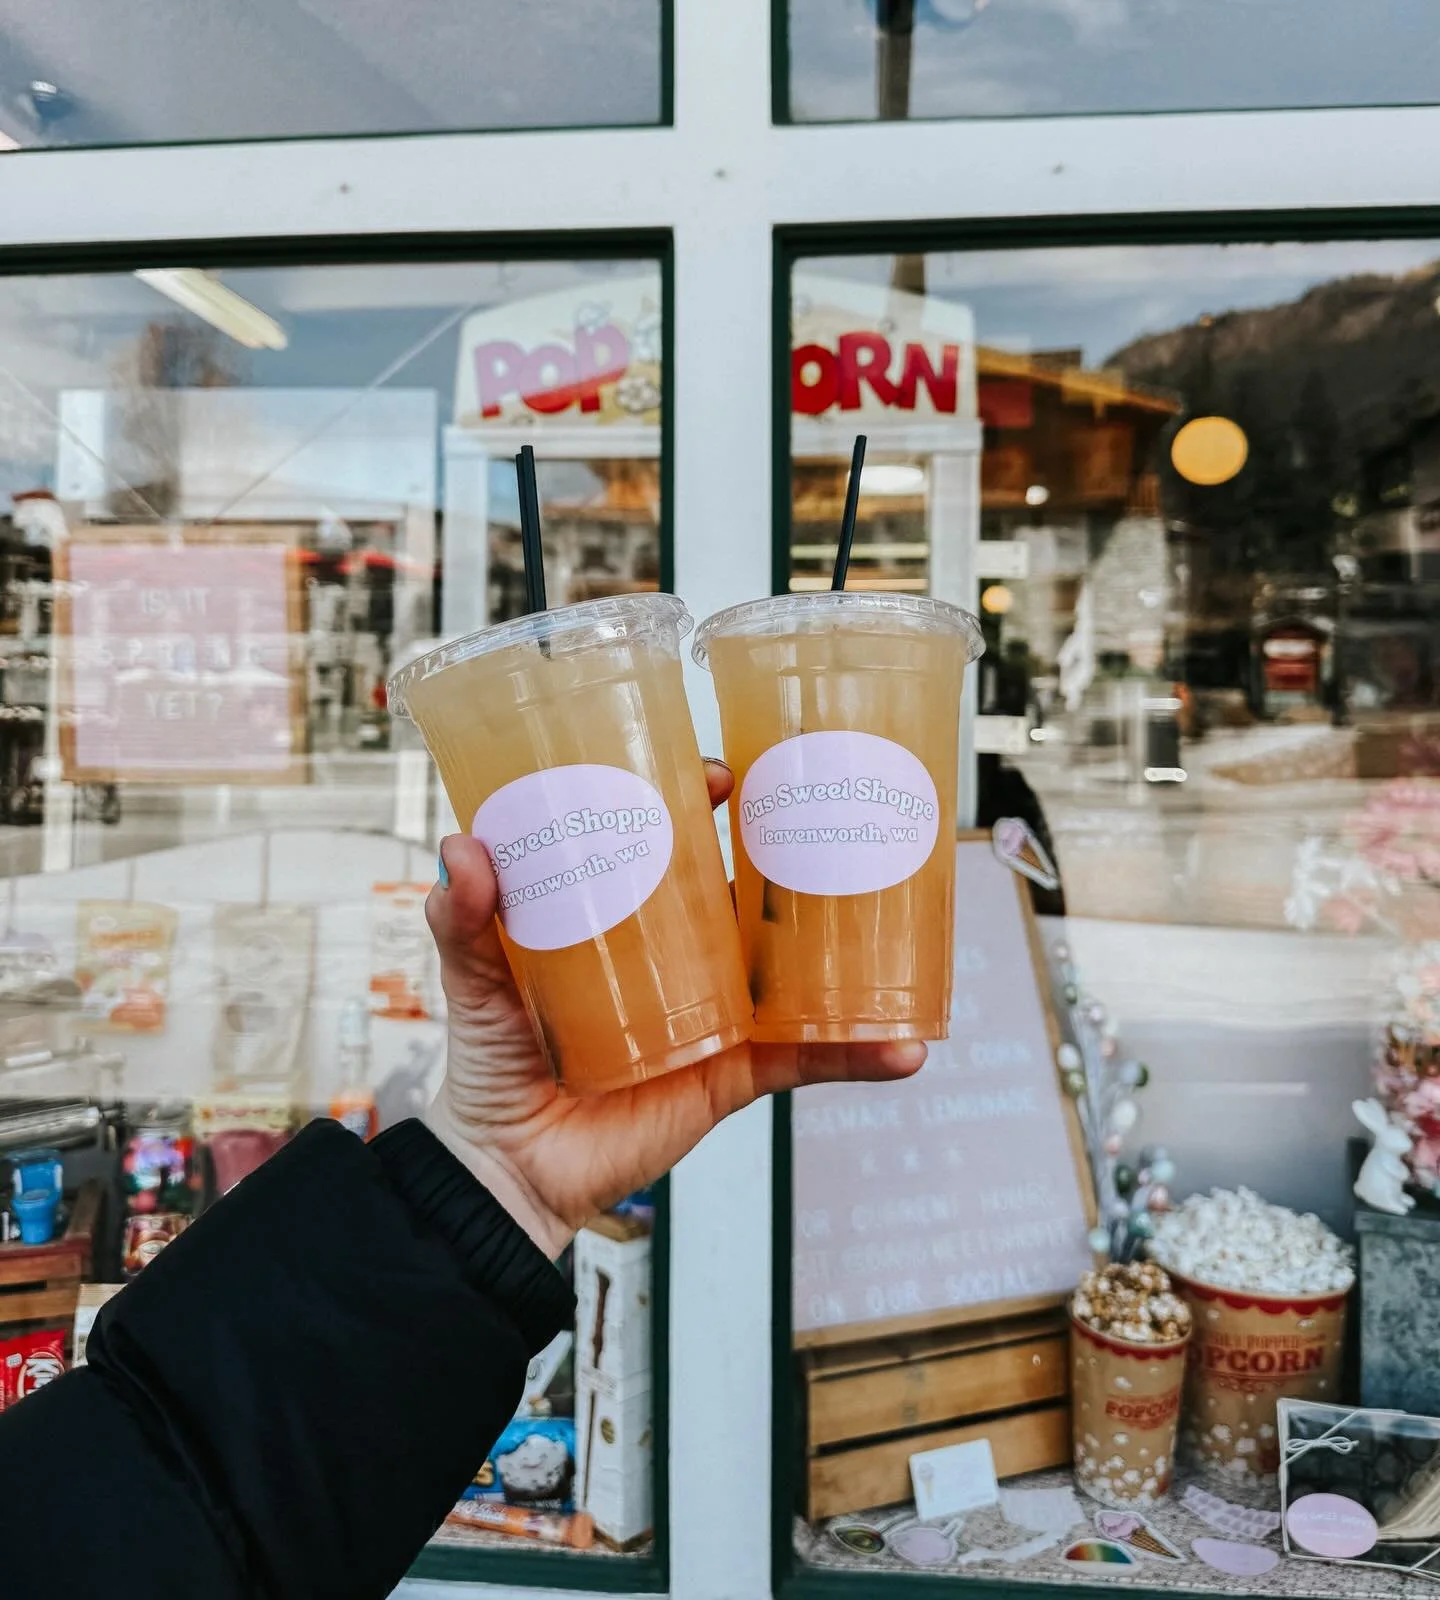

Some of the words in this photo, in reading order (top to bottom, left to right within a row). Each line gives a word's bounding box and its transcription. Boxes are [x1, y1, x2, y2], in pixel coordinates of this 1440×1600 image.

[474, 323, 630, 419] POP
[791, 329, 961, 416] ORN
[743, 795, 775, 825] Das
[776, 778, 850, 808] Sweet
[854, 777, 935, 820] Shoppe
[494, 818, 564, 870] Sweet
[564, 807, 662, 838] Shoppe
[616, 840, 651, 864] wa
[759, 823, 887, 845] leavenworth,
[890, 826, 918, 844] wa
